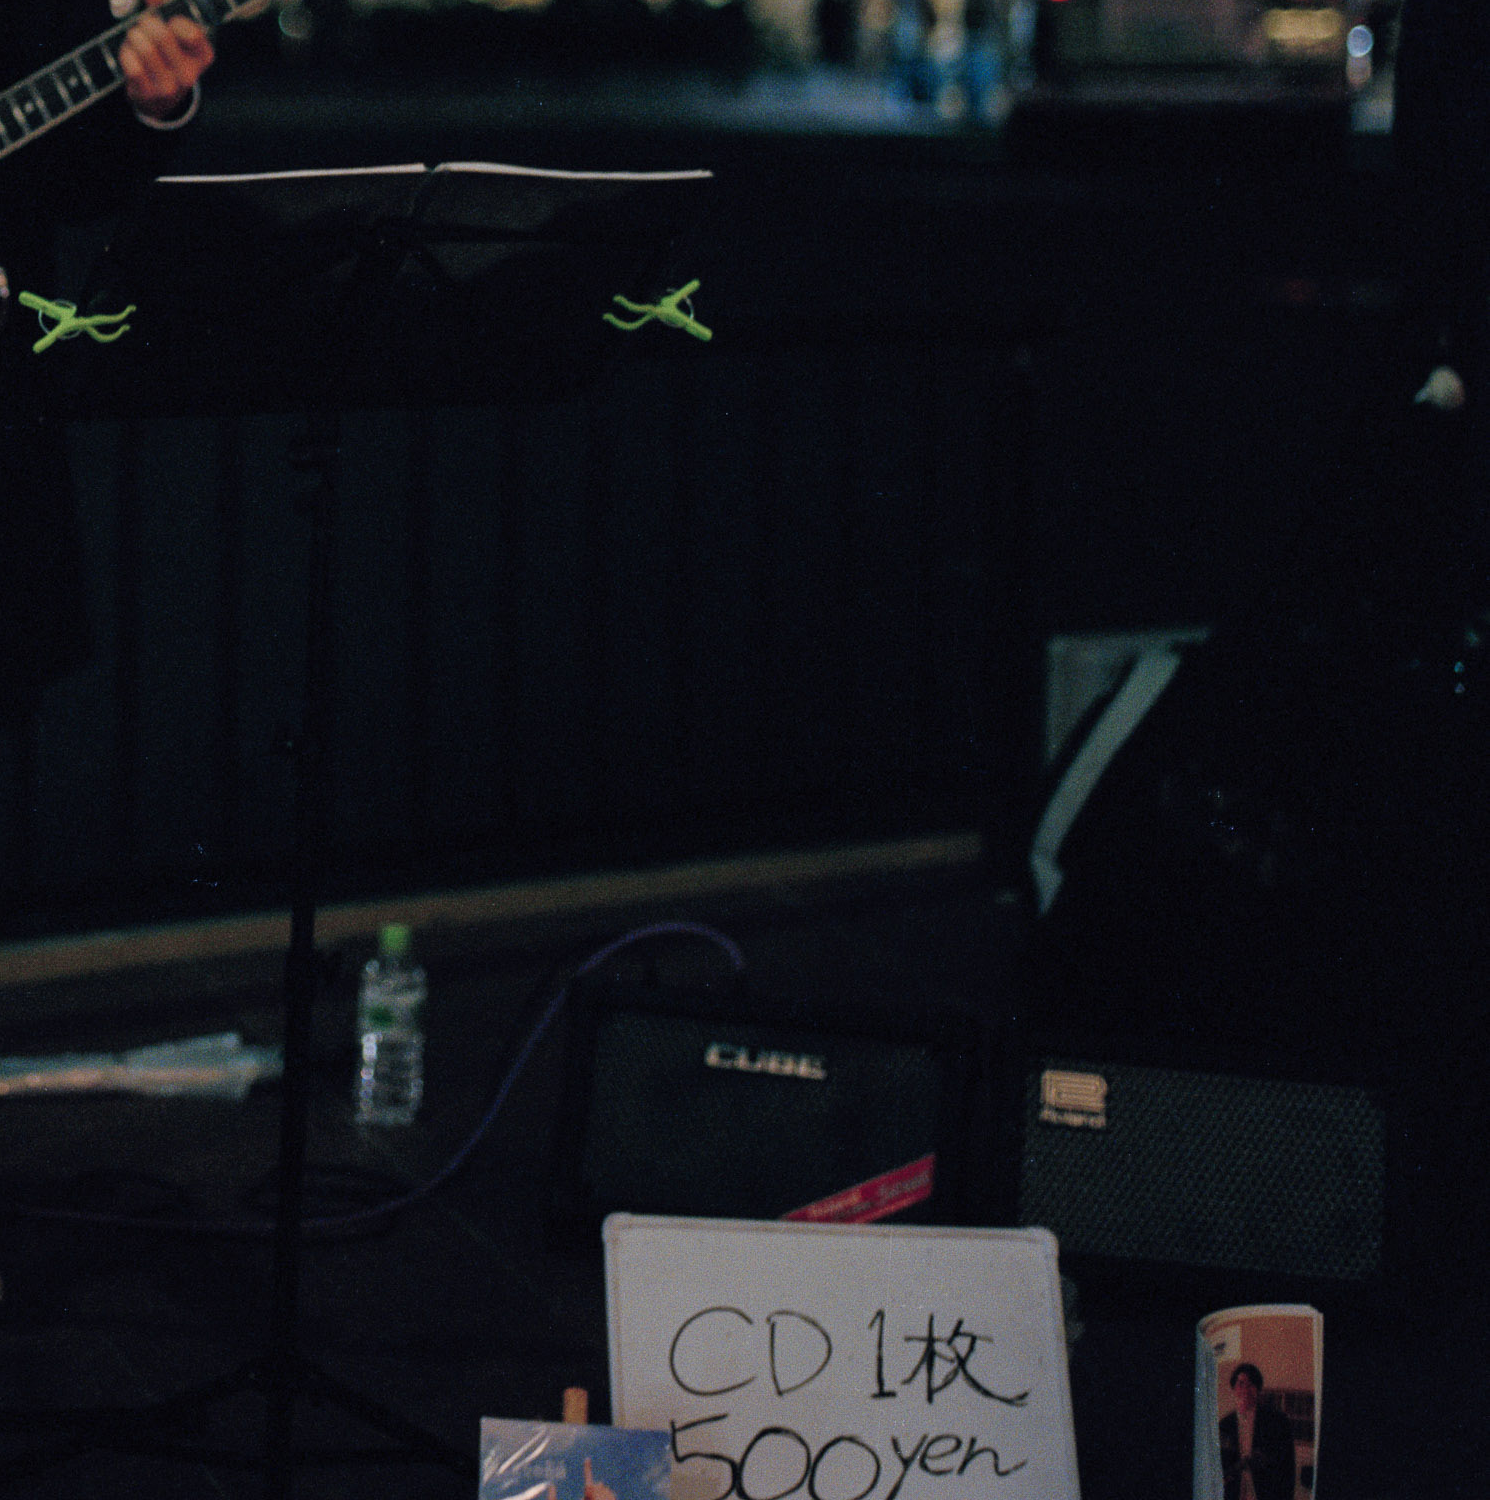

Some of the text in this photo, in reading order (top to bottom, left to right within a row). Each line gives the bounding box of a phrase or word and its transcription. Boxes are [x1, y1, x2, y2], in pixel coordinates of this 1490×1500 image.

[704, 1042, 829, 1081] CUBE
[669, 1305, 1031, 1406] CD 1枚
